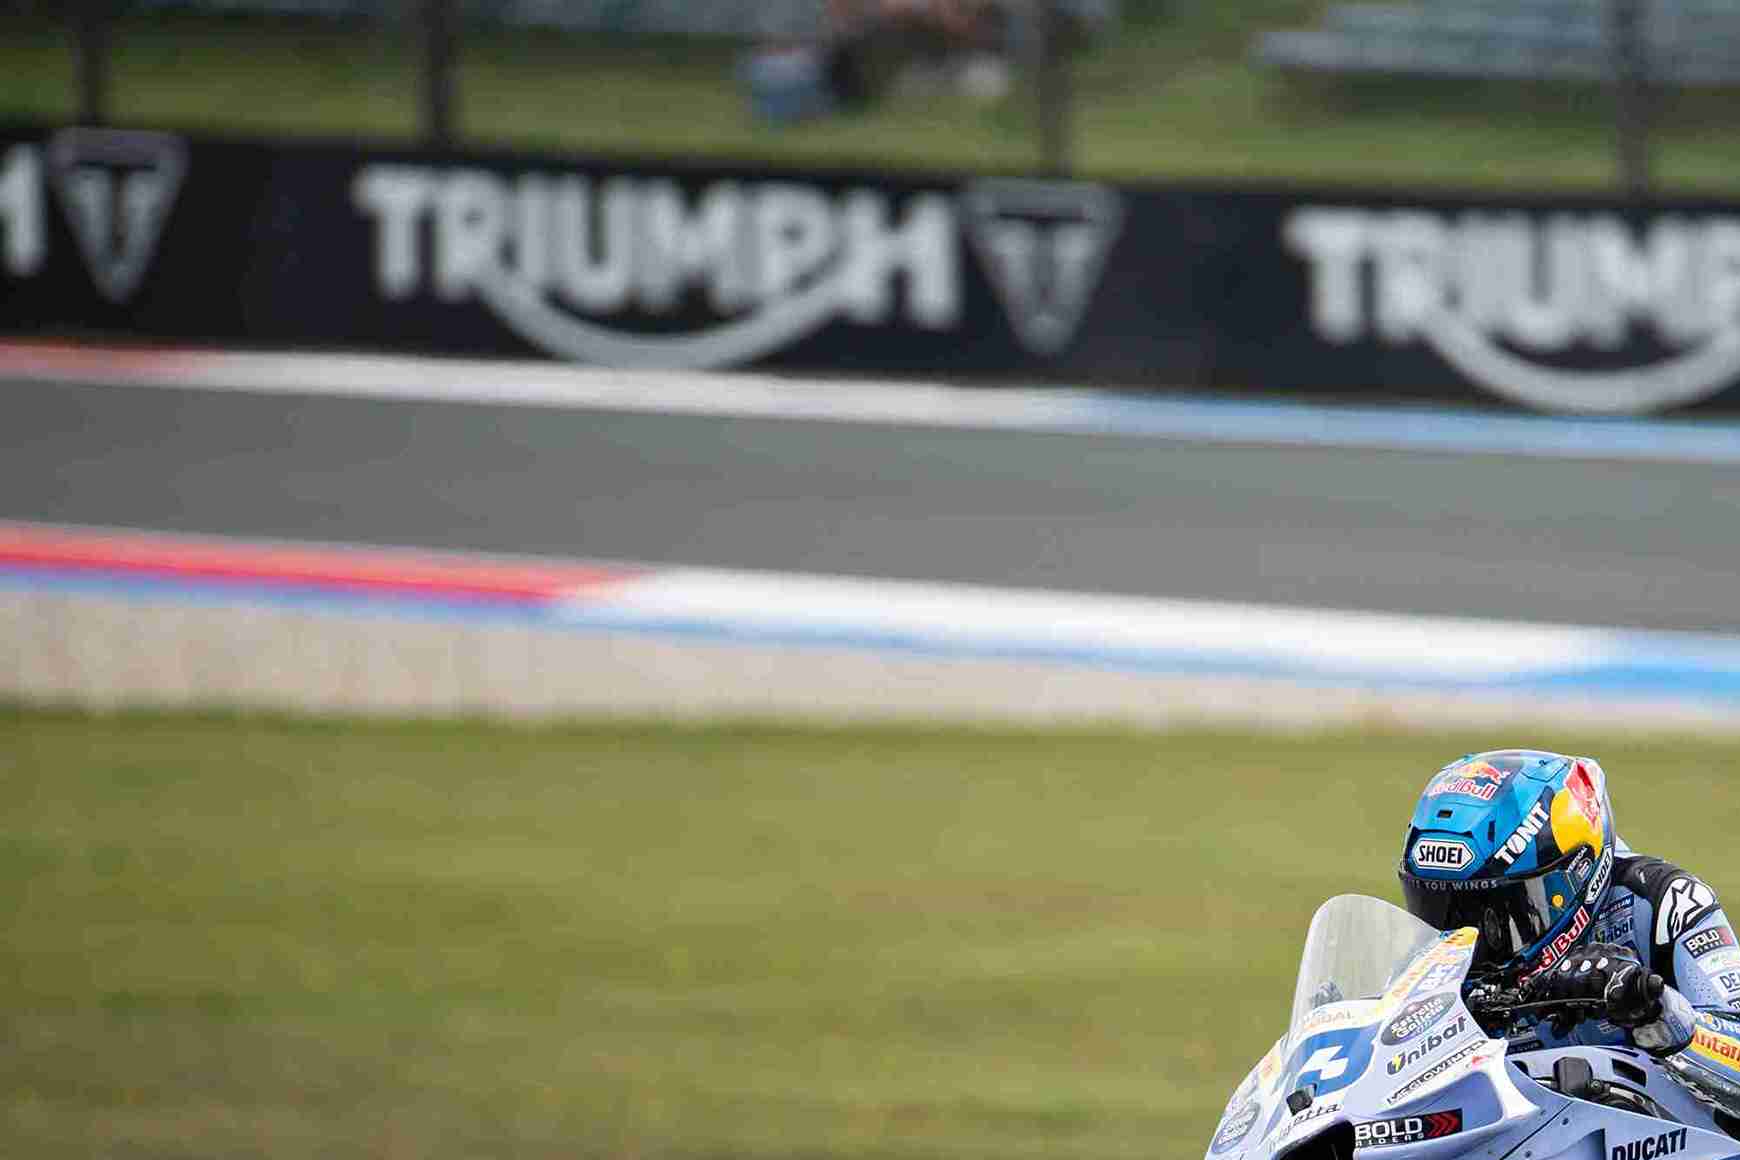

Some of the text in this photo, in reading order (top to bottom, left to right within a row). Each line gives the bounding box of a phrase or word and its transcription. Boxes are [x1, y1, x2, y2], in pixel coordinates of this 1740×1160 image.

[352, 162, 962, 372] TRIUMPH
[1418, 844, 1463, 865] SHOEI
[1452, 879, 1498, 891] WINGS
[1590, 850, 1611, 897] SHOEI
[1552, 906, 1590, 958] Bull
[1686, 929, 1720, 951] BOLD
[1386, 1016, 1466, 1076] Unibat
[1354, 1117, 1423, 1139] BOLD
